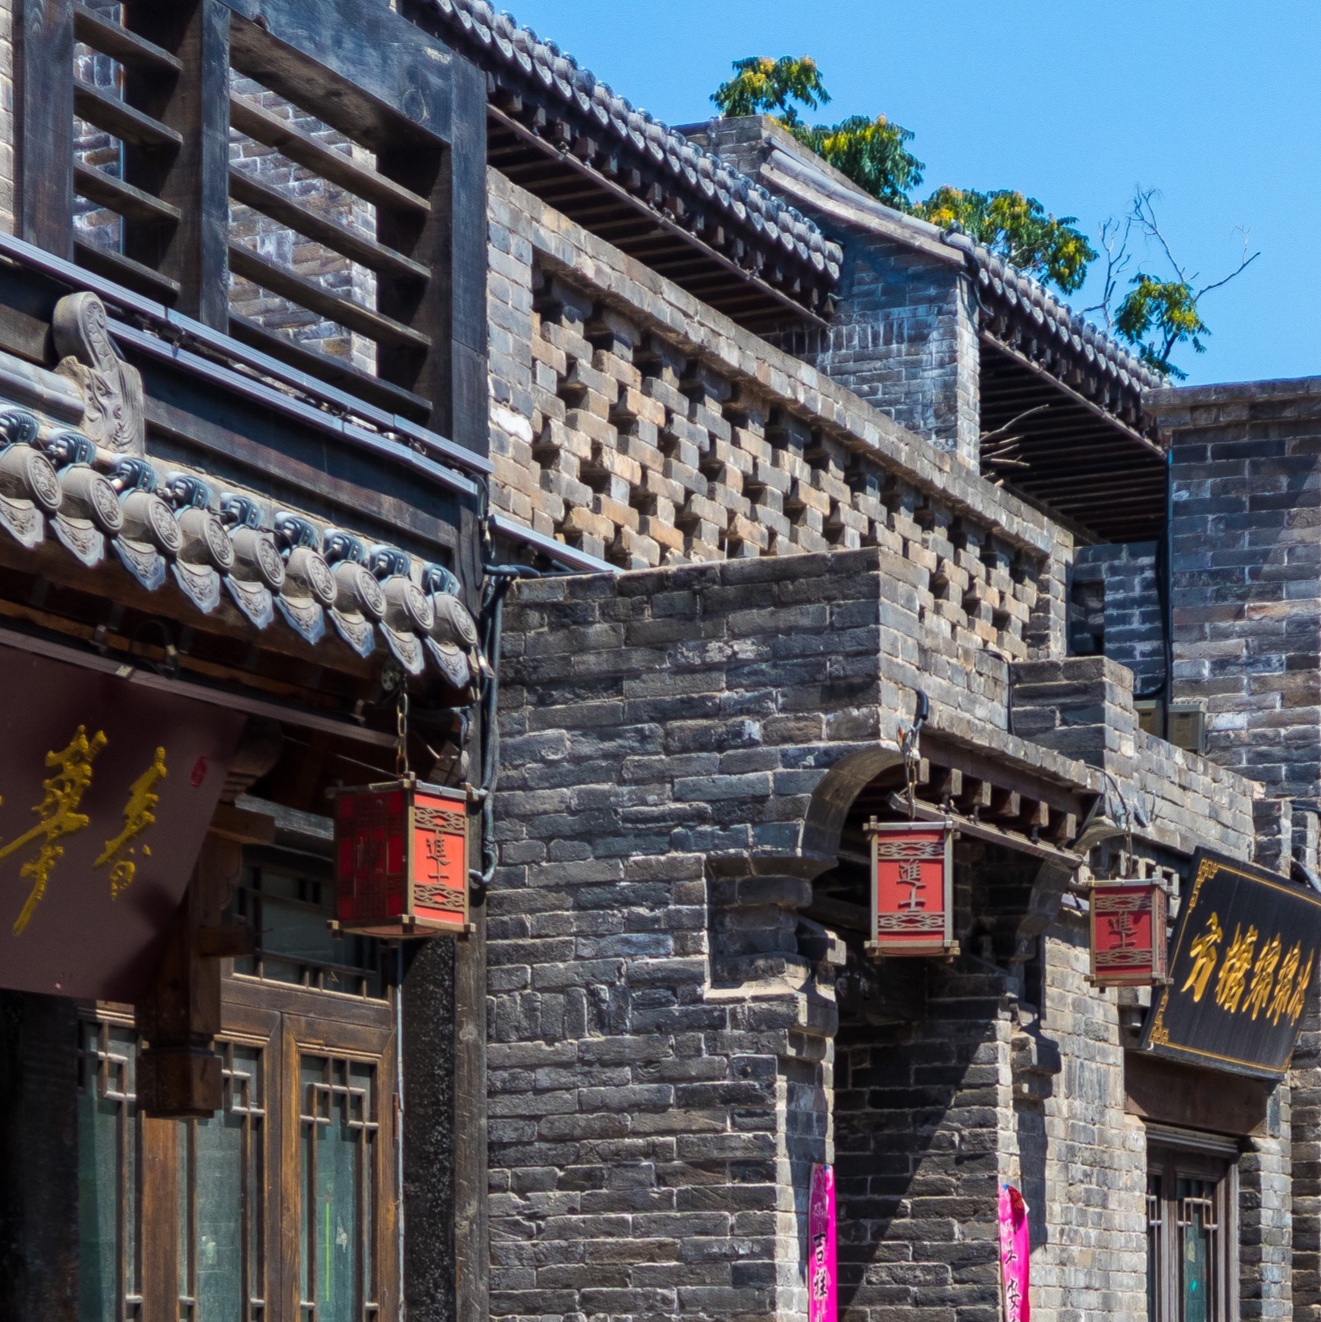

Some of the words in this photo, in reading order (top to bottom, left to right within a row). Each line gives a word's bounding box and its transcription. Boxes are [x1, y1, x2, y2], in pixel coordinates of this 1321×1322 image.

[426, 829, 452, 888] 進士
[896, 858, 927, 914] 進士
[1109, 910, 1138, 951] 進士
